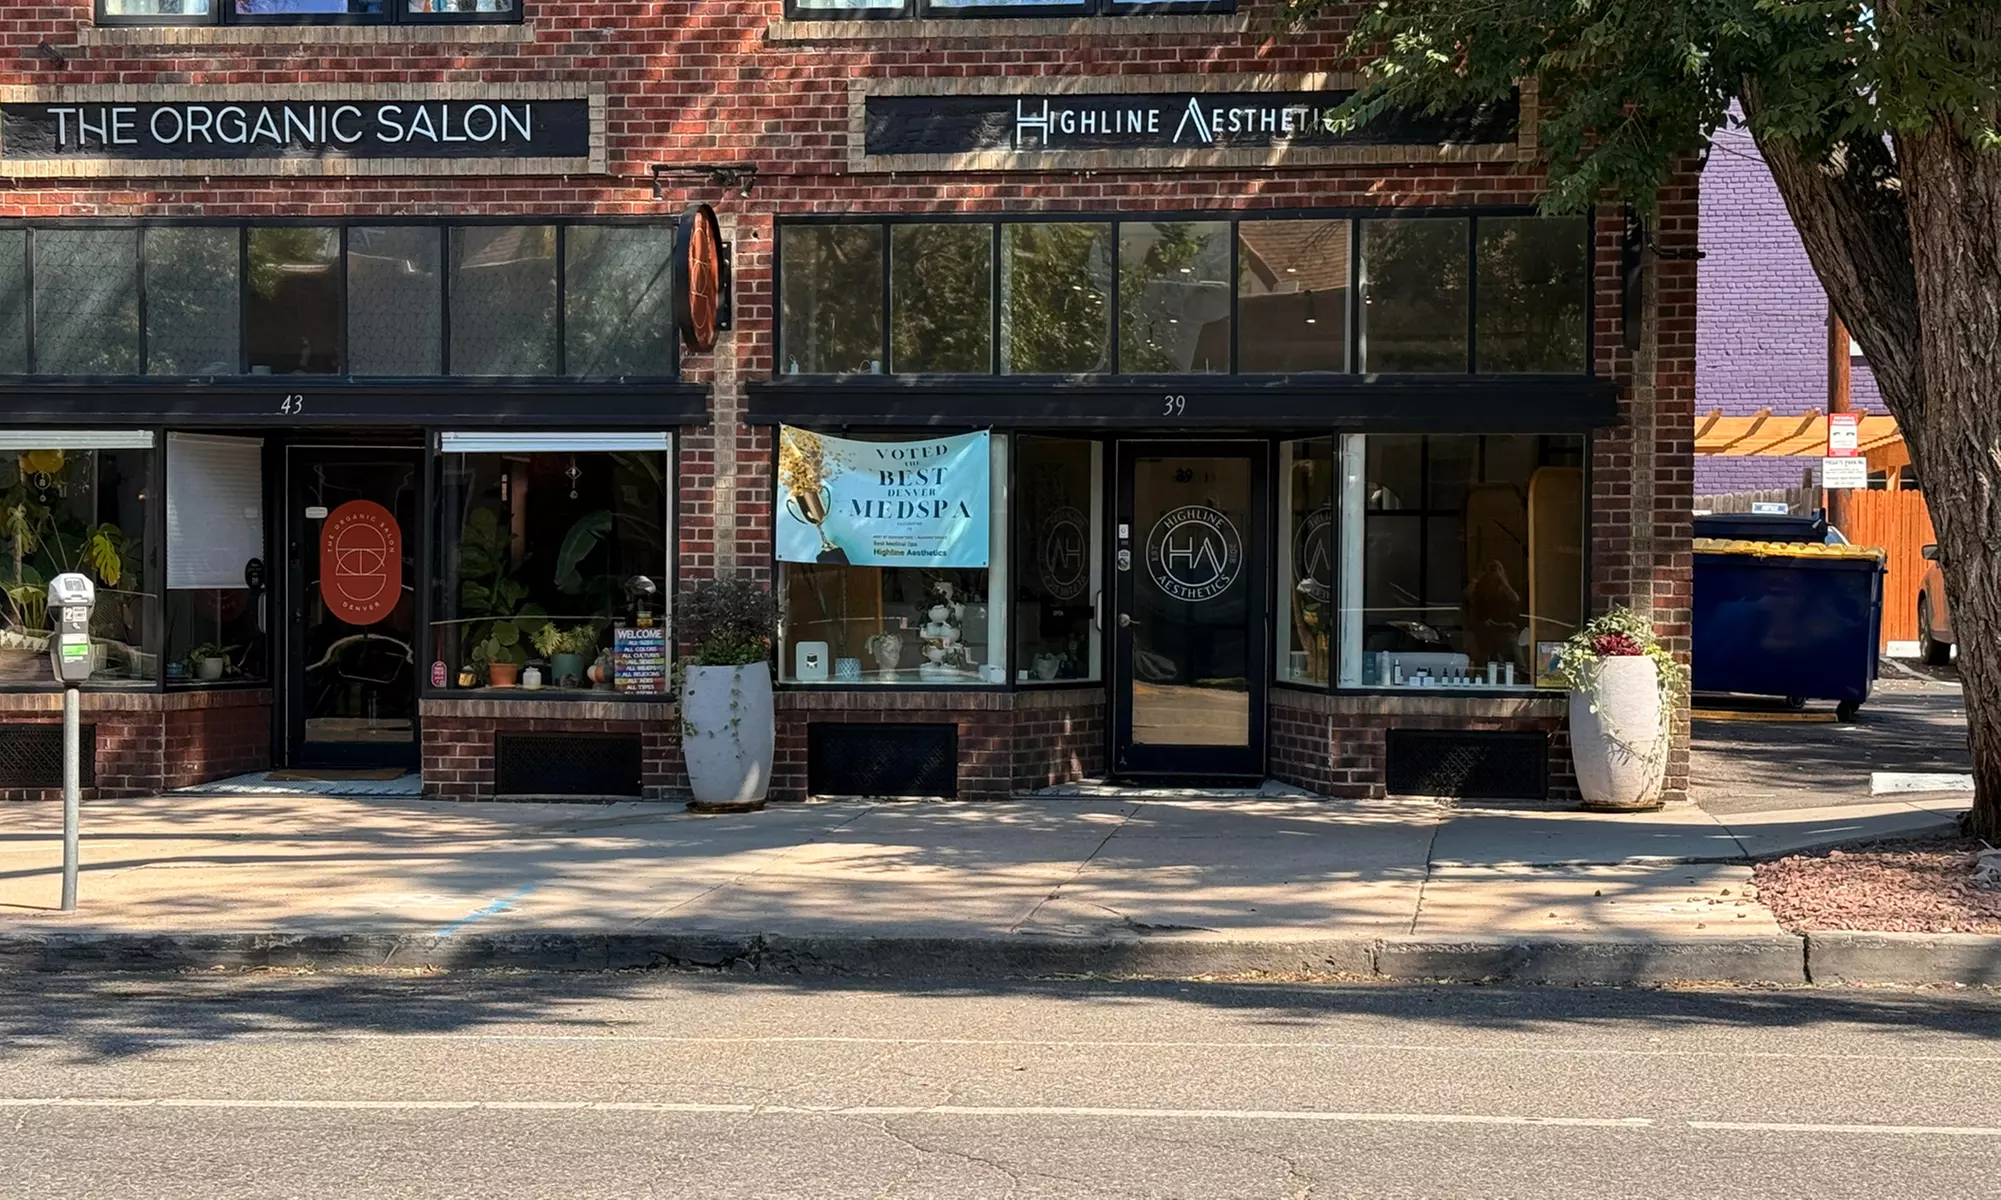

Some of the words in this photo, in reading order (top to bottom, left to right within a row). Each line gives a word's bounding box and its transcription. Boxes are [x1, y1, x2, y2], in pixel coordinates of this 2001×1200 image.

[47, 107, 138, 145] THE
[150, 105, 363, 144] ORGANIC
[376, 103, 531, 143] SALON
[280, 394, 304, 415] 43
[1162, 394, 1186, 417] 39
[875, 444, 948, 460] VOTED
[878, 466, 948, 487] BEST
[887, 488, 937, 497] DENVER
[849, 498, 972, 519] MEDSPA
[1162, 509, 1226, 529] HIGHLINE
[327, 534, 335, 553] THE
[334, 513, 377, 531] ORGANIC
[380, 521, 396, 553] SALON
[873, 548, 905, 557] Highline
[906, 548, 948, 557] Aesthetics
[1157, 573, 1231, 599] AESTHETICS
[65, 607, 73, 620] 2
[342, 601, 381, 612] DENVER
[617, 629, 663, 639] WELCOME
